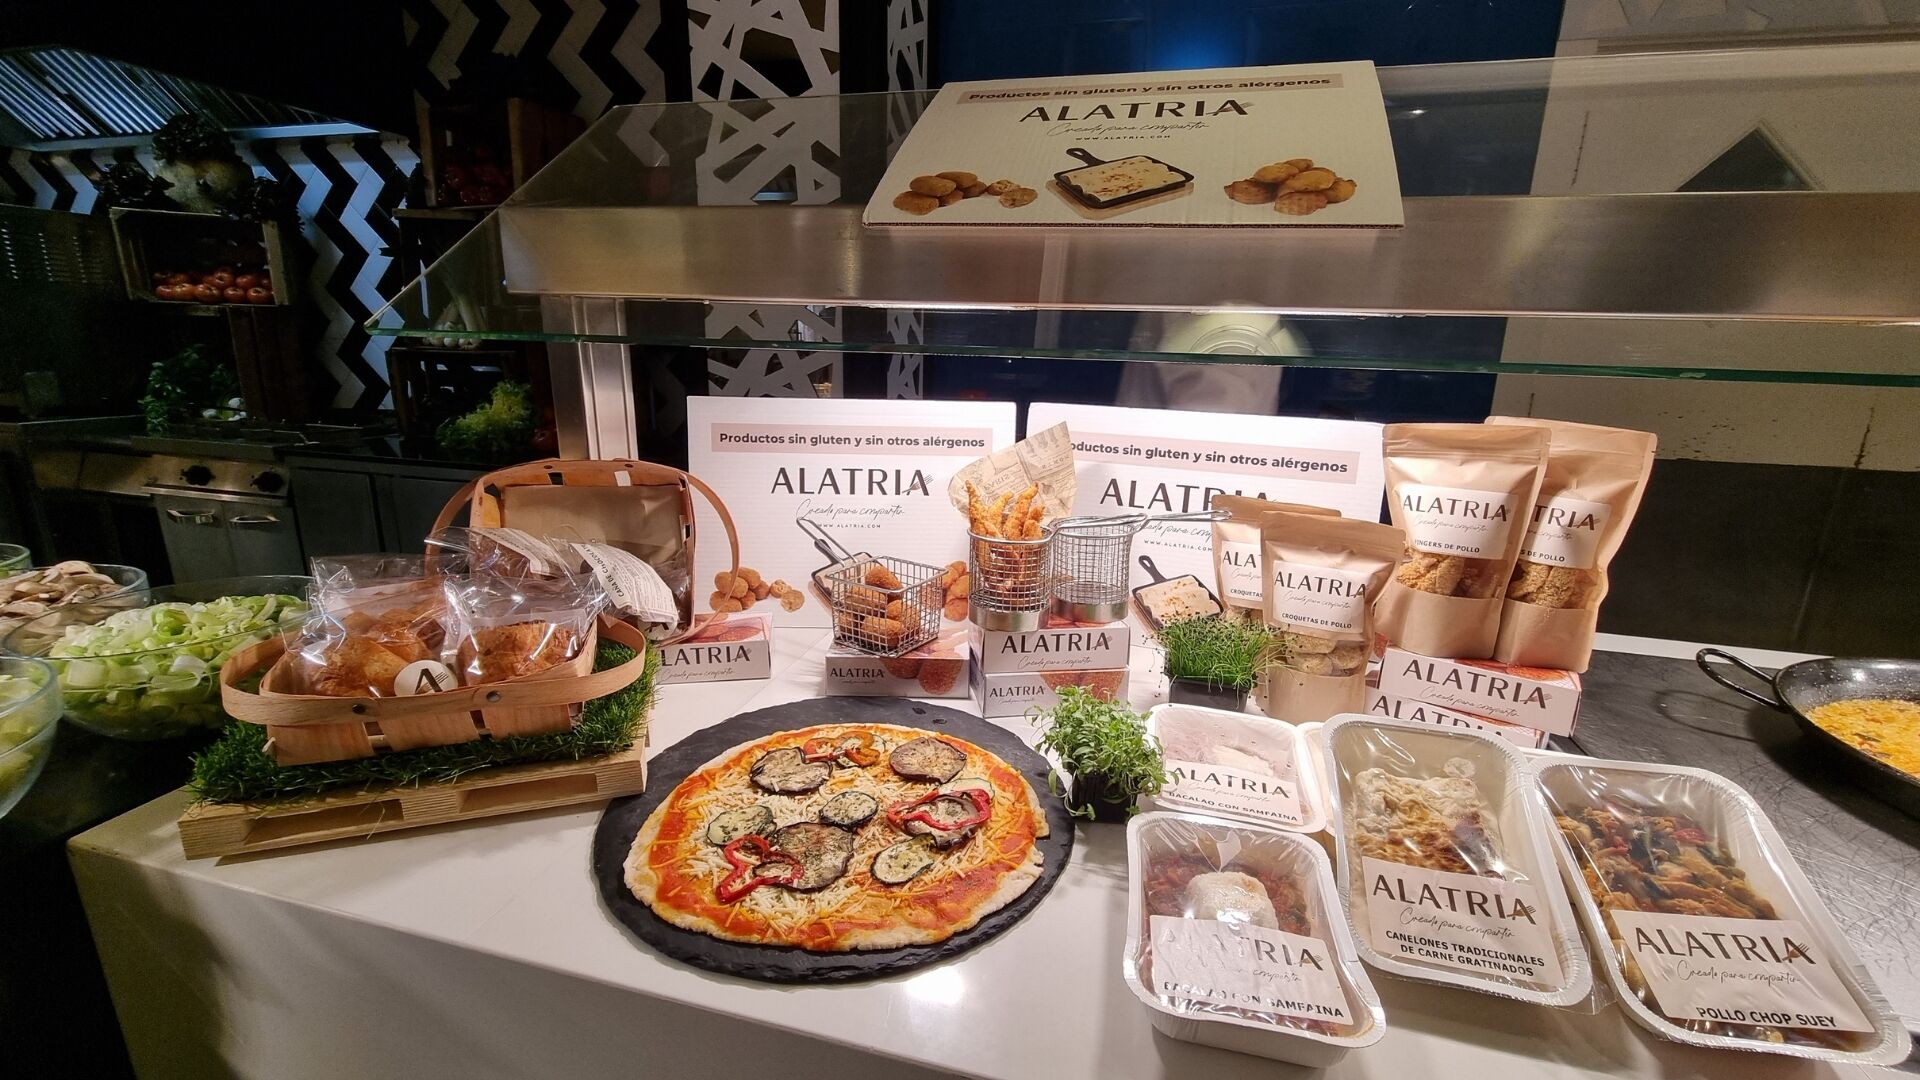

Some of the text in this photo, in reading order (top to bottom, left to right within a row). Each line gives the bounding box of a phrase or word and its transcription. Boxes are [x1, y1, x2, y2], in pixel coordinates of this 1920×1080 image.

[969, 91, 1050, 100] Productos
[1054, 88, 1078, 96] sin
[1082, 86, 1137, 96] gluten
[1157, 83, 1182, 91] sin
[1187, 82, 1234, 90] otros
[1238, 78, 1332, 88] alérgenos
[1019, 99, 1249, 123] ALATRIA
[719, 432, 985, 448] Productos sin gluten y sin otros alérgenos
[1070, 441, 1348, 473] oductos sin gluten y sin otros alérgenos
[771, 467, 931, 496] ALATRIA
[1100, 478, 1267, 513] ALATR
[1403, 495, 1508, 523] ALATRIA
[1534, 505, 1596, 531] TRIA
[1444, 543, 1455, 551] DE
[1456, 545, 1480, 554] POLLO
[1539, 552, 1566, 562] POLLO
[1230, 588, 1262, 598] CROQUETAS
[1274, 571, 1367, 599] ALATRIA
[1281, 612, 1319, 624] CROQUETAS
[1330, 621, 1352, 629] POLLO
[1001, 632, 1110, 654] ALATRIA
[660, 645, 751, 667] LATRIA
[830, 667, 885, 678] ALATRIA
[1402, 659, 1547, 709] ALATRIA
[990, 686, 1045, 698] ALATRIA
[1174, 767, 1290, 798] ALATRIA
[1168, 791, 1215, 806] BACALAO
[1242, 807, 1298, 822] SAMFAINA
[1373, 874, 1537, 925] ALATRIA
[1400, 906, 1439, 925] Creado
[1438, 919, 1464, 931] para
[1386, 930, 1545, 967] CANELONES TRADICIONALES
[1635, 927, 1816, 965] ALATRIA
[1400, 944, 1534, 977] DE CARNE GRATINADOS
[1676, 959, 1719, 981] Creado
[1720, 970, 1746, 983] para
[1269, 998, 1345, 1018] SAMFAINA
[1696, 1006, 1837, 1028] POLLO CHOP SUEY
